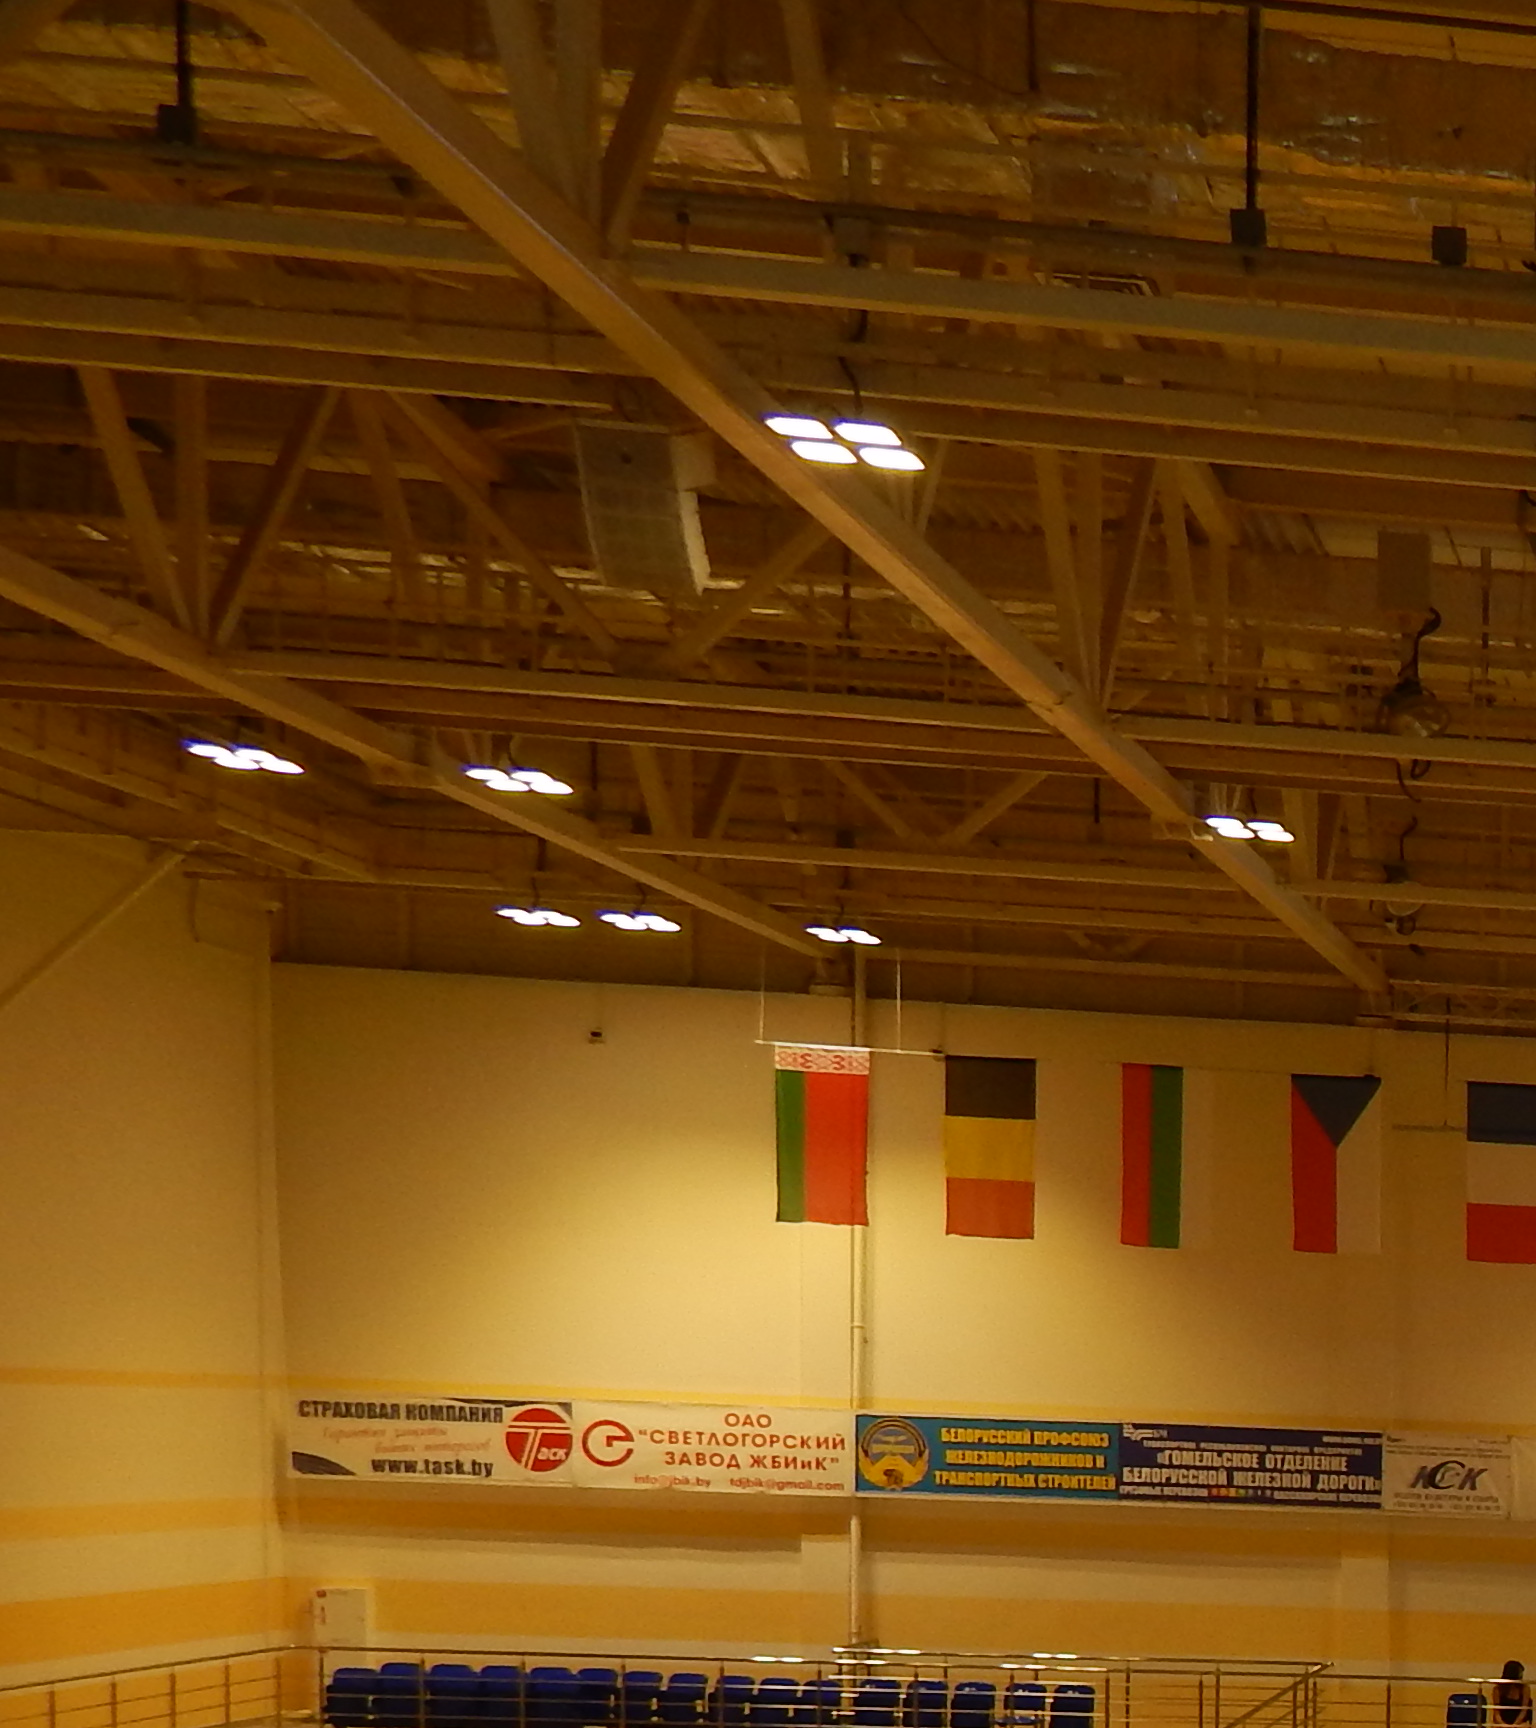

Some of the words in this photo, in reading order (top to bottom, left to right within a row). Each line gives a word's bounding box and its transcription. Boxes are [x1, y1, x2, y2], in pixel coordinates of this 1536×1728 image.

[299, 1400, 400, 1419] СТРАХОВАЯ
[405, 1404, 503, 1422] КОМПАНИЯ
[724, 1412, 772, 1428] ОАО
[638, 1429, 846, 1451] "СВЕТЛОГОРСКИЙ
[940, 1427, 1031, 1445] БЕЛОРУССКИЙ
[1034, 1431, 1110, 1447] ПРОФСОЮЗ
[371, 1459, 494, 1477] www.task.by
[664, 1451, 741, 1470] ЗАВОД
[945, 1450, 1091, 1468] ЖЕЛЕЗНОДОРОЖНИКОВ
[1265, 1454, 1348, 1471] ОТДЕЛЕНИЕ
[934, 1471, 1036, 1488] ТРАНСПОРТНЫХ
[1038, 1473, 1116, 1490] СТРОИТЕЛЕЙ
[1122, 1467, 1228, 1486] БЕЛОРУССКОЙ
[1233, 1471, 1311, 1489] ЖЕЛЕЗНОЙ
